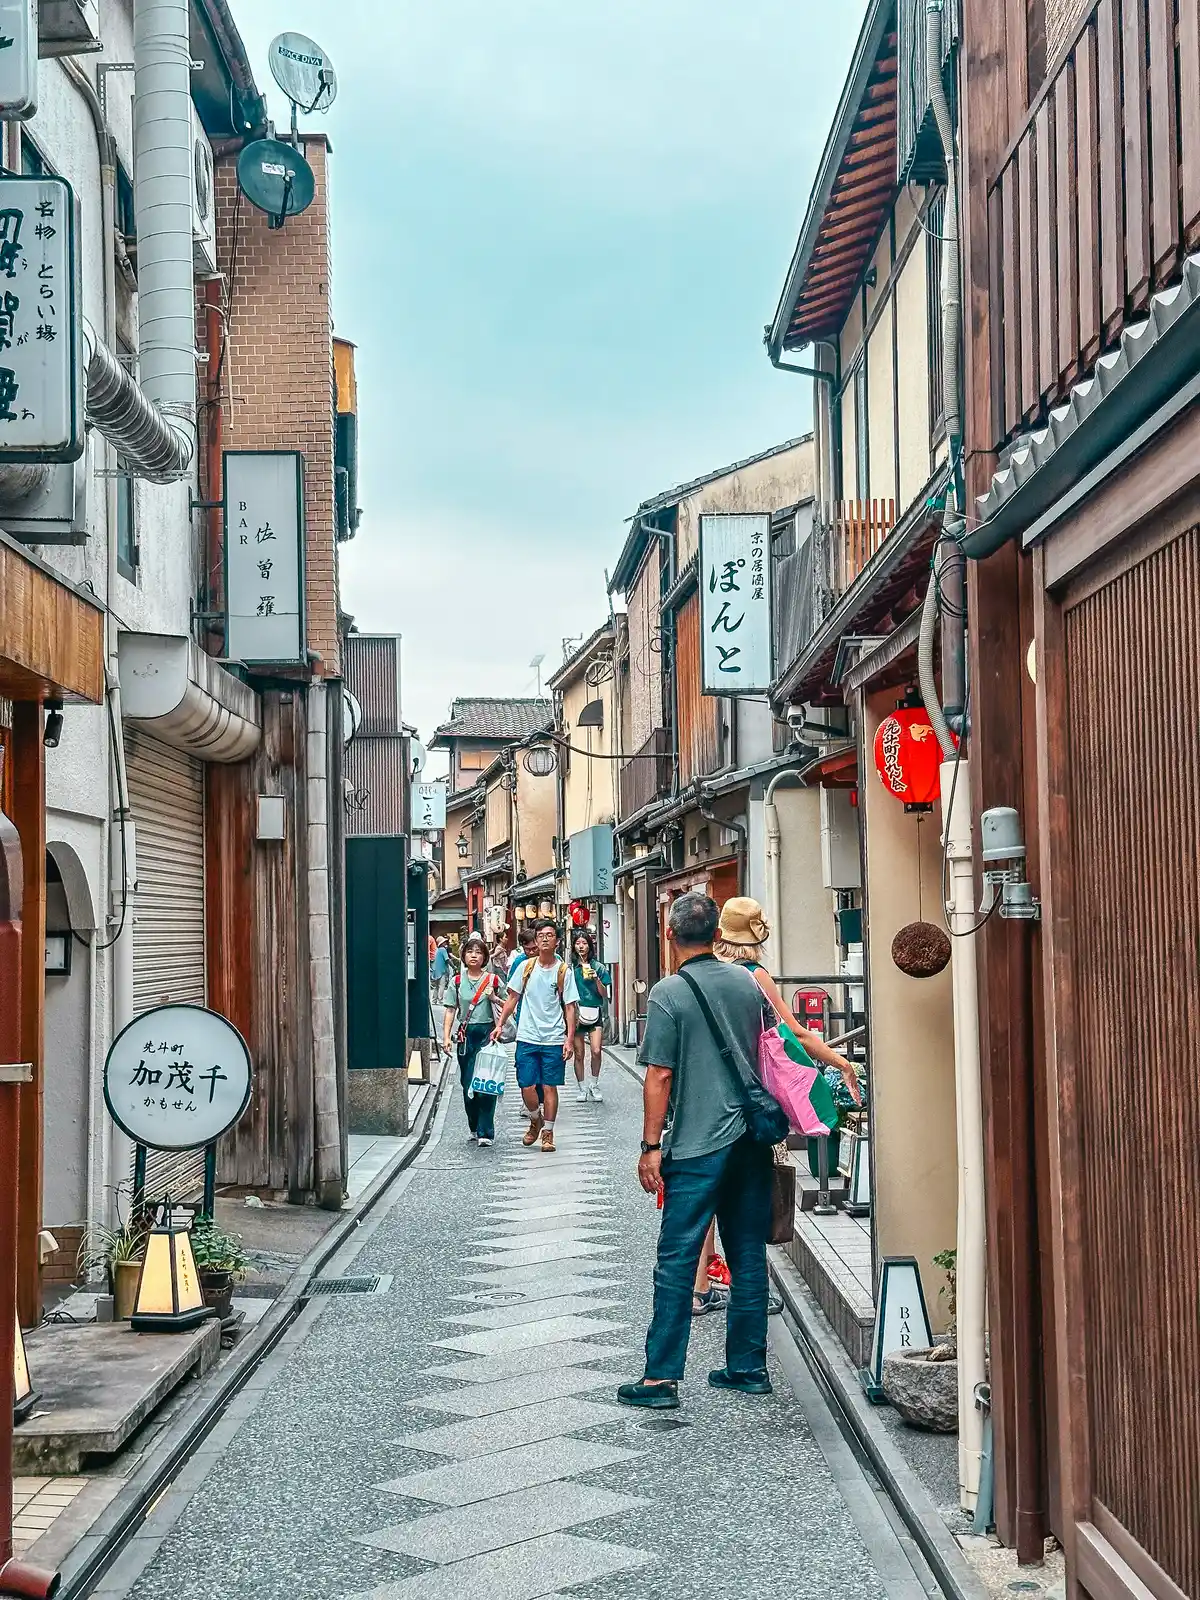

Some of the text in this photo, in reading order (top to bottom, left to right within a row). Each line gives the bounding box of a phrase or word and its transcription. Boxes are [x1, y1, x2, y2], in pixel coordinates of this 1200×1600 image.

[279, 47, 300, 61] SPACE
[34, 201, 57, 240] 名物
[238, 501, 249, 545] BAR
[750, 531, 765, 601] 京の居酒屋
[709, 558, 746, 673] ぽんと
[883, 719, 907, 792] 先斗町のれん会
[142, 1040, 185, 1056] 先斗町
[128, 1059, 228, 1104] 加茂千
[143, 1096, 198, 1112] かもせん
[900, 1306, 912, 1347] BAR
